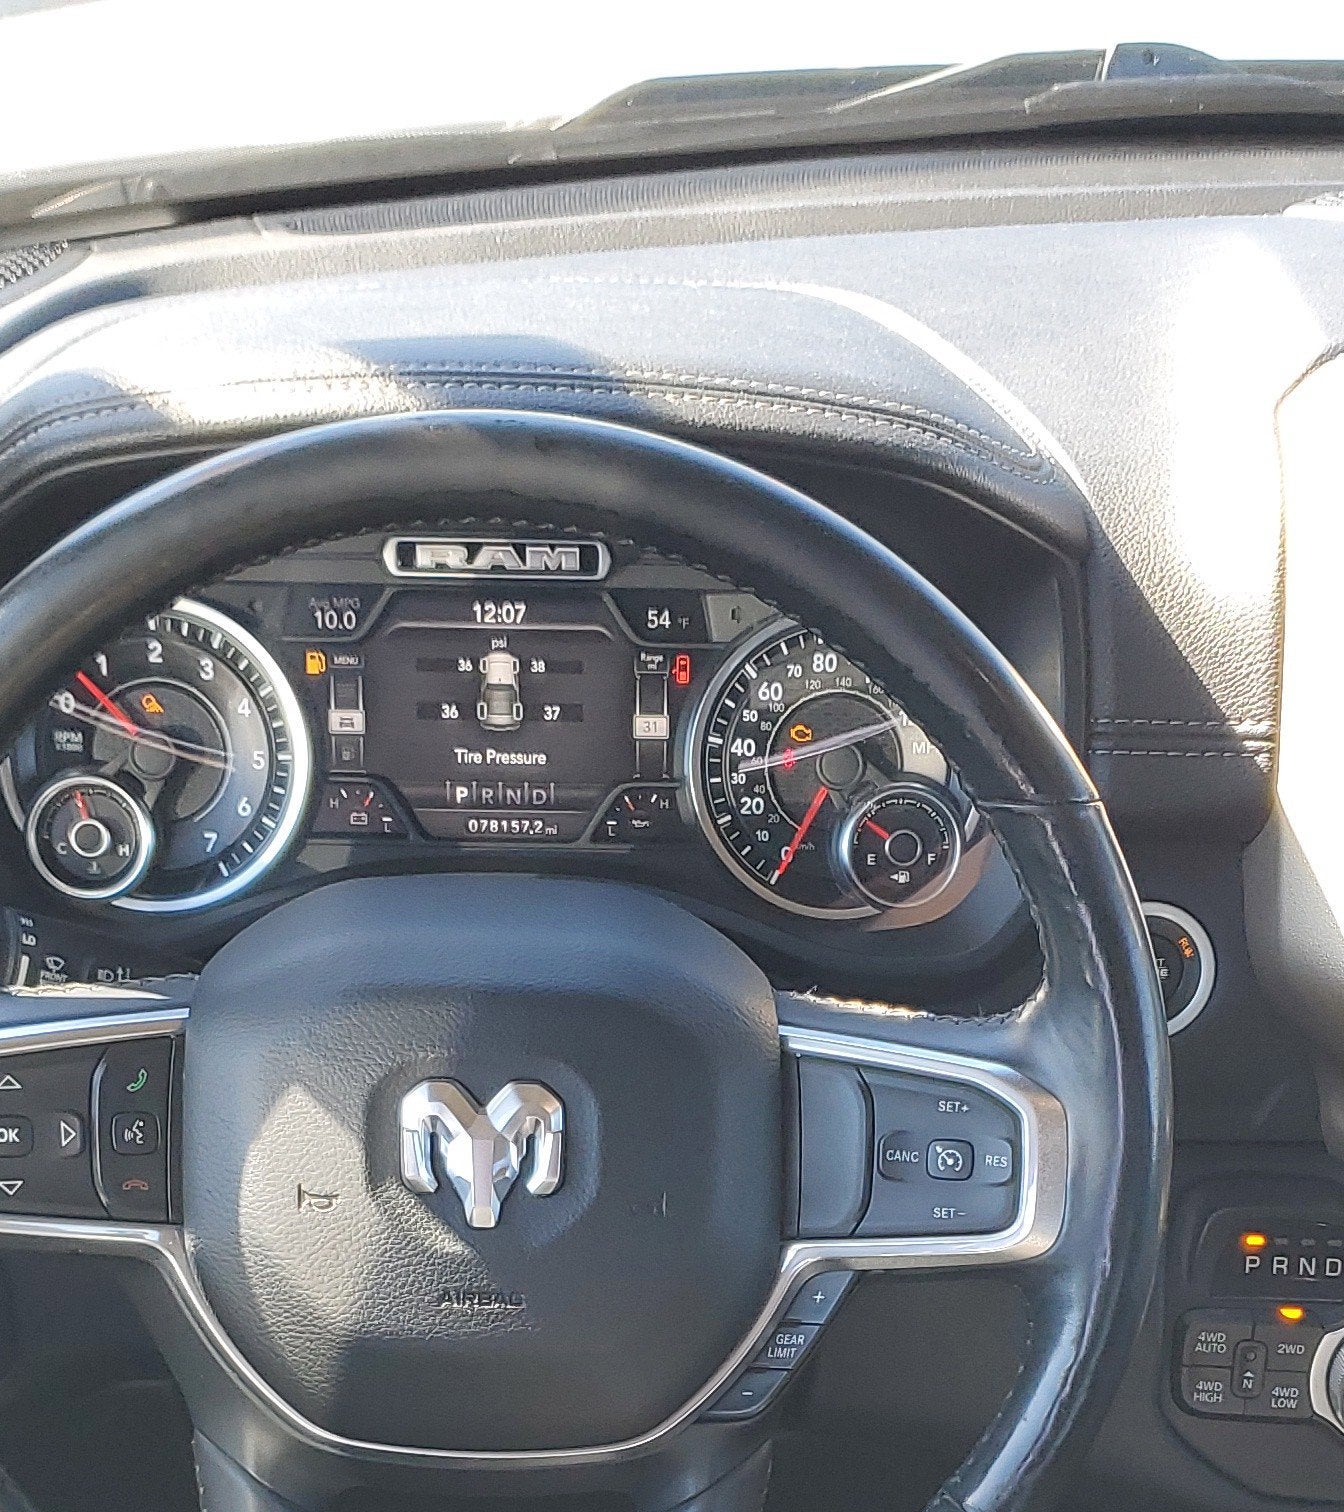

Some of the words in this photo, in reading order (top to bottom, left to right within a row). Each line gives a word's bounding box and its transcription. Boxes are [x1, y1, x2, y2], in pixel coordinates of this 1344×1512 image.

[416, 543, 580, 571] RAM
[473, 601, 526, 624] 12:07
[647, 607, 671, 629] 54
[314, 610, 357, 630] 10.0
[491, 636, 508, 650] psi
[146, 640, 164, 663] 2
[94, 652, 108, 676] 1
[457, 657, 473, 672] 36
[530, 657, 546, 673] 38
[812, 653, 838, 673] 80
[199, 659, 215, 681] 3
[786, 664, 803, 678] 70
[805, 679, 823, 690] 120
[834, 676, 852, 688] 140
[758, 681, 783, 701] 60
[237, 697, 252, 718] 4
[441, 704, 459, 719] 36
[543, 705, 561, 721] 37
[768, 702, 785, 713] 100
[742, 709, 758, 722] 50
[642, 721, 659, 734] 31
[760, 721, 772, 731] 80
[731, 738, 756, 757] 40
[252, 749, 265, 770] 5
[454, 749, 482, 764] Tire
[486, 749, 547, 765] Pressure
[731, 773, 746, 785] 30
[455, 786, 469, 804] P
[481, 787, 494, 805] R
[506, 787, 521, 805] N
[532, 788, 547, 805] D
[753, 784, 766, 795] 40
[237, 796, 252, 816] 6
[329, 798, 339, 809] H
[659, 799, 669, 810] H
[740, 797, 765, 815] 20
[768, 814, 780, 824] 20
[468, 819, 543, 835] 078157.2
[545, 822, 557, 835] mi
[204, 831, 218, 852] 7
[756, 830, 769, 842] 10
[58, 844, 67, 855] C
[867, 854, 877, 866] E
[927, 853, 936, 866] F
[886, 1149, 919, 1163] CANC
[985, 1155, 1007, 1168] RES
[1245, 1256, 1261, 1274] P
[1272, 1257, 1288, 1275] R
[1298, 1258, 1317, 1276] N
[1325, 1259, 1343, 1277] D
[776, 1333, 805, 1346] GEAR
[1197, 1331, 1227, 1342] 4WD
[767, 1347, 797, 1359] LIMIT
[1195, 1342, 1227, 1354] AUTO
[1277, 1343, 1305, 1355] 2WD
[1196, 1381, 1223, 1392] 4WD
[1242, 1378, 1253, 1389] N
[1193, 1392, 1223, 1403] HIGH
[1271, 1386, 1299, 1398] 4WD
[1271, 1398, 1298, 1409] LOW
